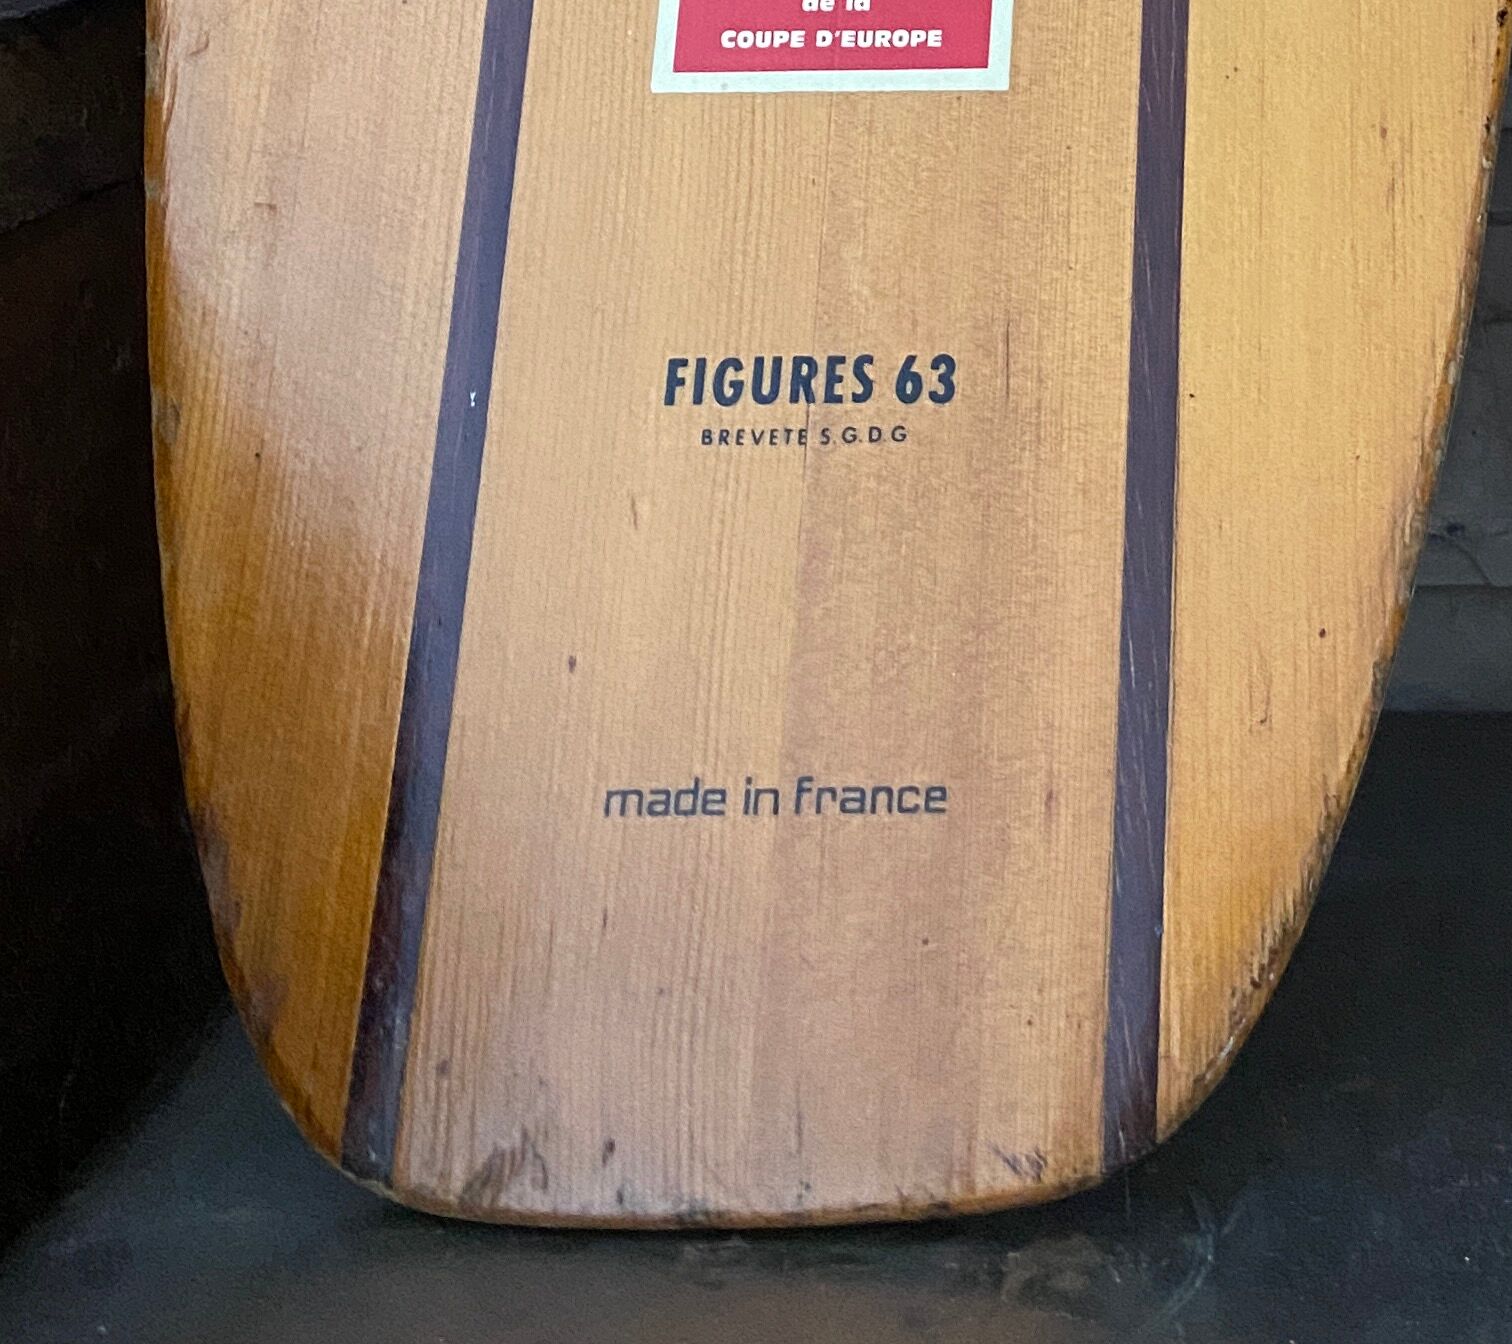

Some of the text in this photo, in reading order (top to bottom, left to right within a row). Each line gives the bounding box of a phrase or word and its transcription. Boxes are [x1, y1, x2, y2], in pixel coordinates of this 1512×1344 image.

[720, 28, 943, 48] COUPE D'EUROPE
[663, 353, 957, 406] FIGURES 63
[603, 776, 948, 817] made in france
